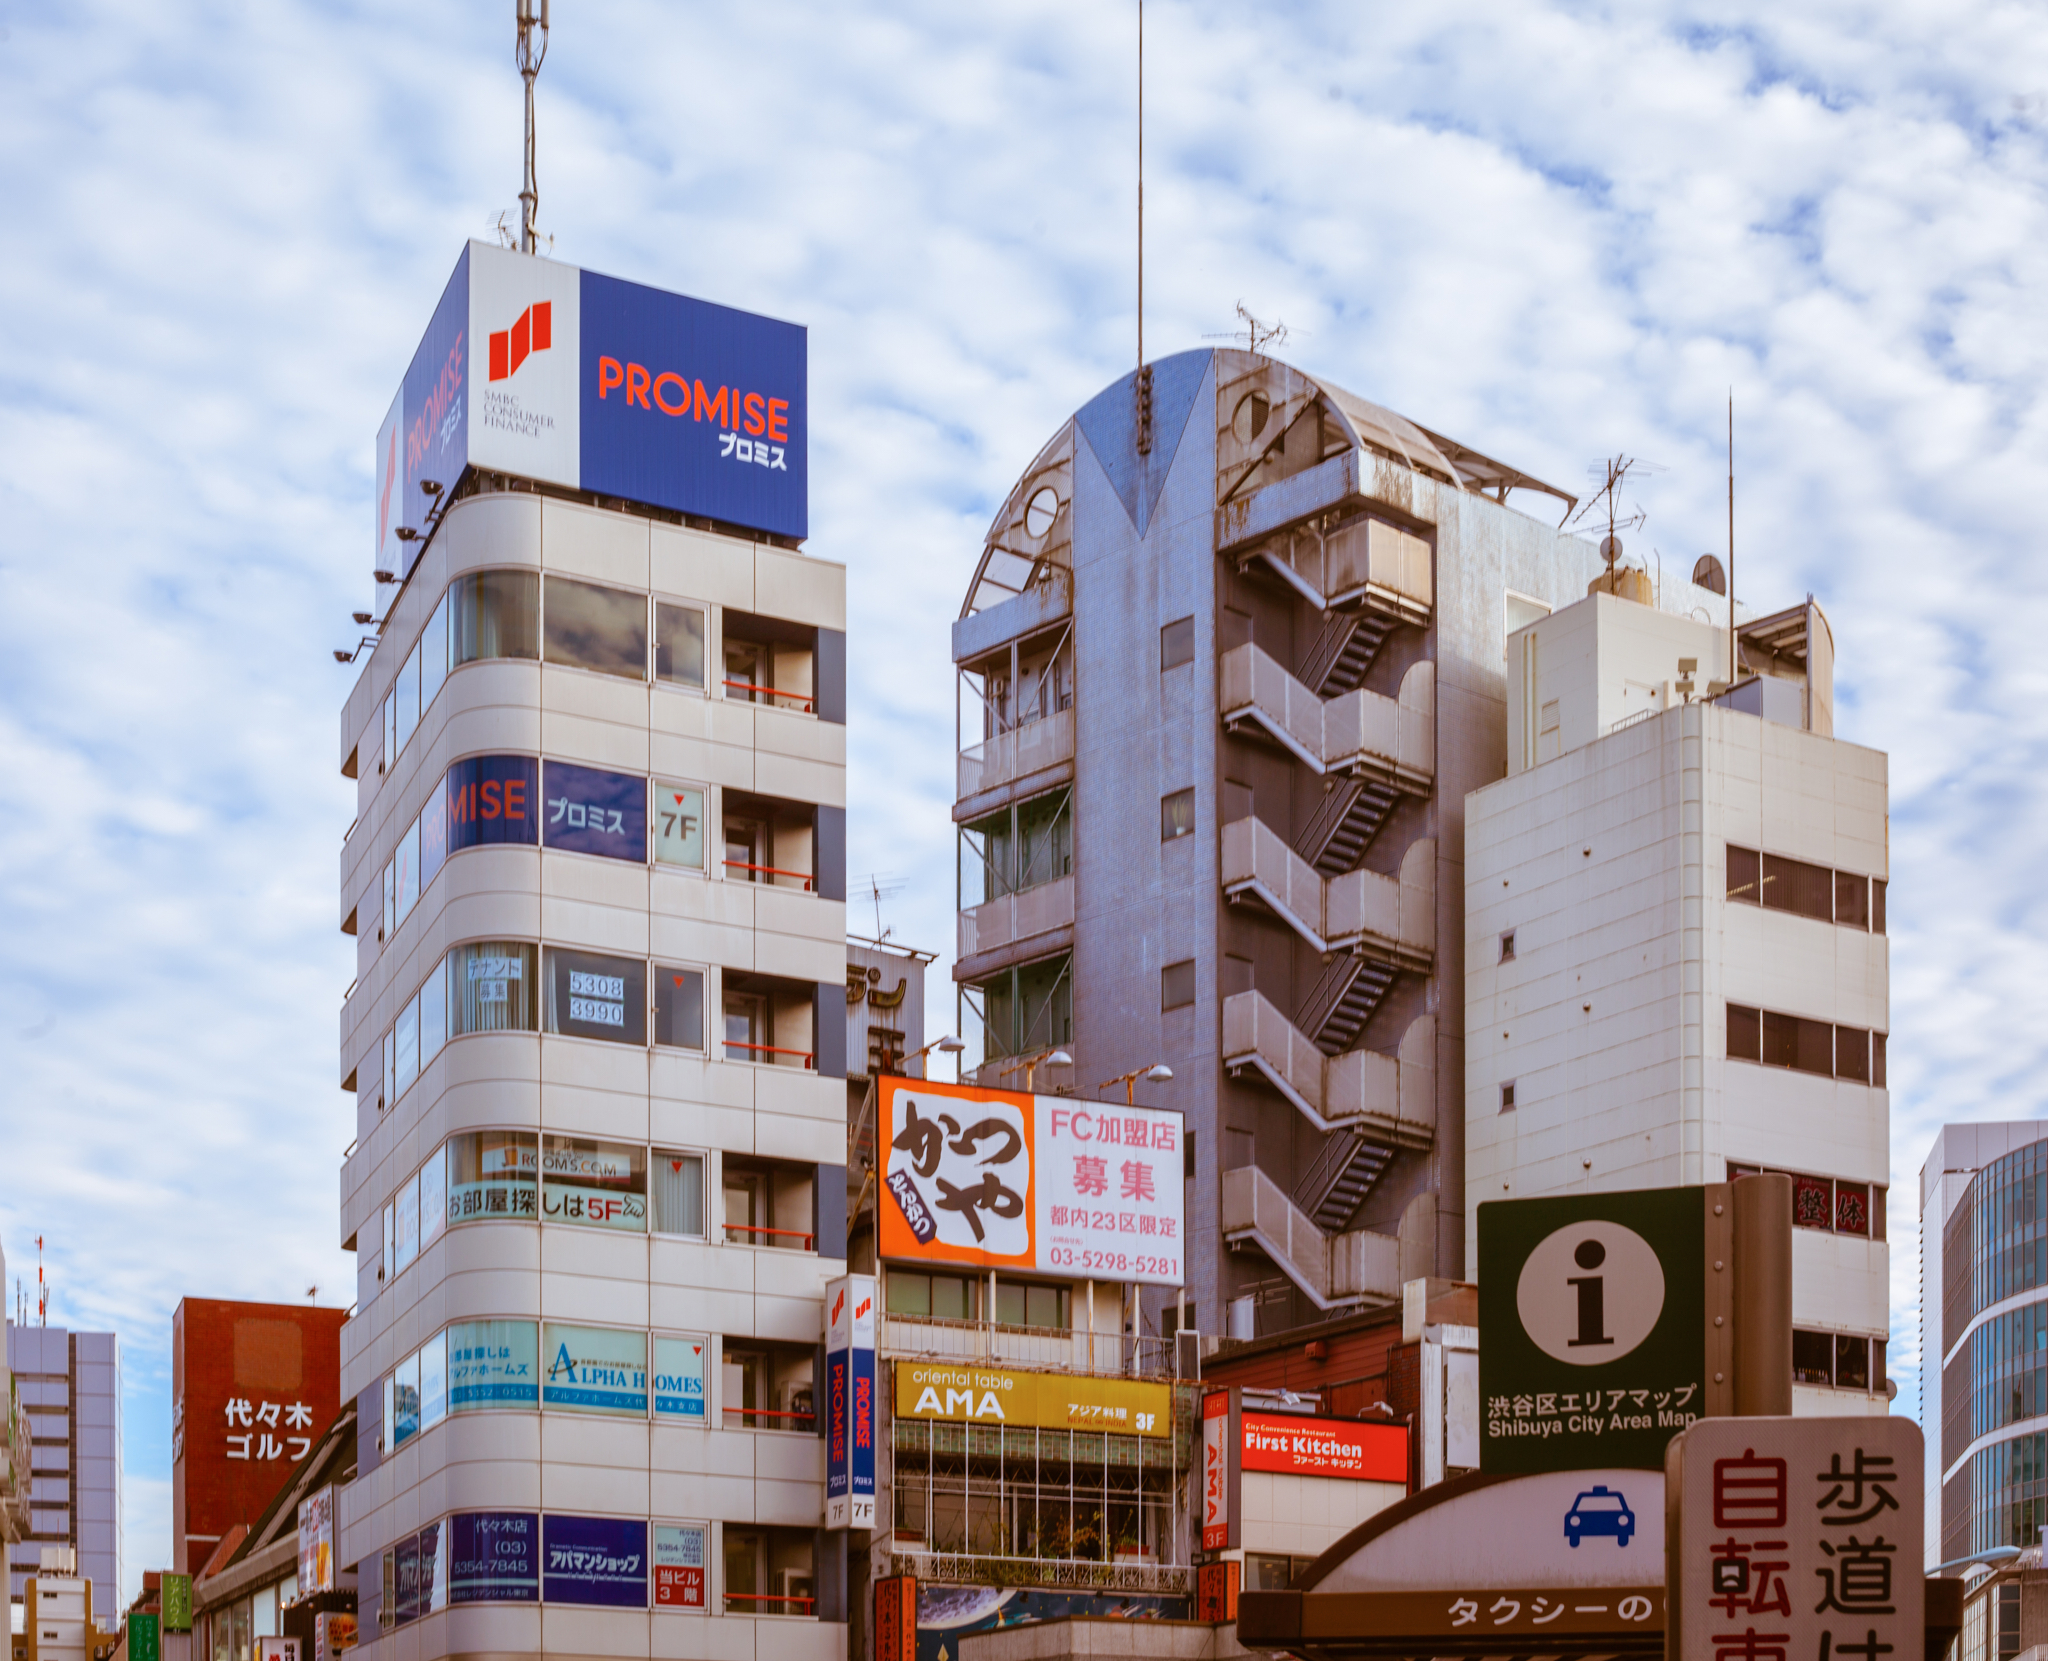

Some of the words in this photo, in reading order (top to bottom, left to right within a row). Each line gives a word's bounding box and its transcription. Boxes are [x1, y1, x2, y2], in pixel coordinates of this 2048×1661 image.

[408, 329, 463, 485] PROMISE
[484, 388, 519, 408] SMBC
[599, 355, 789, 443] PROMISE
[440, 393, 462, 458] プロミス
[483, 401, 556, 431] CONSUMER
[484, 413, 540, 439] FINANCE
[718, 432, 787, 471] プロミス
[548, 797, 625, 835] プロミス
[660, 811, 698, 841] 7F
[469, 959, 520, 977] テナント
[480, 983, 506, 998] 募集
[572, 973, 622, 998] 5308
[572, 999, 622, 1024] 3990
[1050, 1108, 1176, 1153] FC加盟店
[1072, 1154, 1156, 1202] 募集
[888, 1174, 930, 1236] とんかつ
[1798, 1187, 1865, 1229] 整体
[1050, 1205, 1177, 1239] 都内23区限定
[1050, 1246, 1177, 1277] 03-5298-5281
[550, 1342, 627, 1388] ALPHA
[633, 1372, 702, 1394] HOMES
[913, 1369, 970, 1387] oriental
[975, 1372, 1013, 1391] table
[224, 1397, 313, 1431] 代々木
[833, 1363, 844, 1463] PROMISE
[856, 1377, 870, 1449] PROMISE
[914, 1386, 1005, 1419] AMA
[1067, 1403, 1127, 1420] アジア料理
[1488, 1382, 1698, 1419] 渋谷区エリアマップ
[1067, 1416, 1094, 1426] NEPAL
[1105, 1418, 1127, 1428] INDIA
[1136, 1412, 1155, 1431] 3F
[1246, 1422, 1259, 1432] City
[1260, 1424, 1300, 1435] Convenience
[1302, 1428, 1336, 1438] Restaurant
[1488, 1419, 1563, 1439] Shibuya
[1568, 1415, 1604, 1436] City
[1610, 1413, 1652, 1430] Area
[1658, 1410, 1697, 1430] Map
[226, 1433, 312, 1462] ゴルフ
[1245, 1432, 1288, 1452] First
[1293, 1436, 1362, 1458] Kitchen
[1293, 1455, 1329, 1467] ファースト
[1331, 1458, 1362, 1470] キッチン
[830, 1474, 847, 1488] プロミス
[854, 1476, 872, 1487] プロミス
[1207, 1443, 1217, 1524] AMA
[833, 1504, 844, 1521] 7F
[854, 1503, 873, 1518] 7F
[476, 1519, 528, 1534] 代々木店
[1206, 1531, 1224, 1549] 3F
[495, 1541, 527, 1555] (03)
[454, 1560, 528, 1574] 5354-7845
[551, 1551, 641, 1573] アパマンショップ
[659, 1569, 700, 1585] 当ビル
[1448, 1595, 1666, 1627] タクシーの
